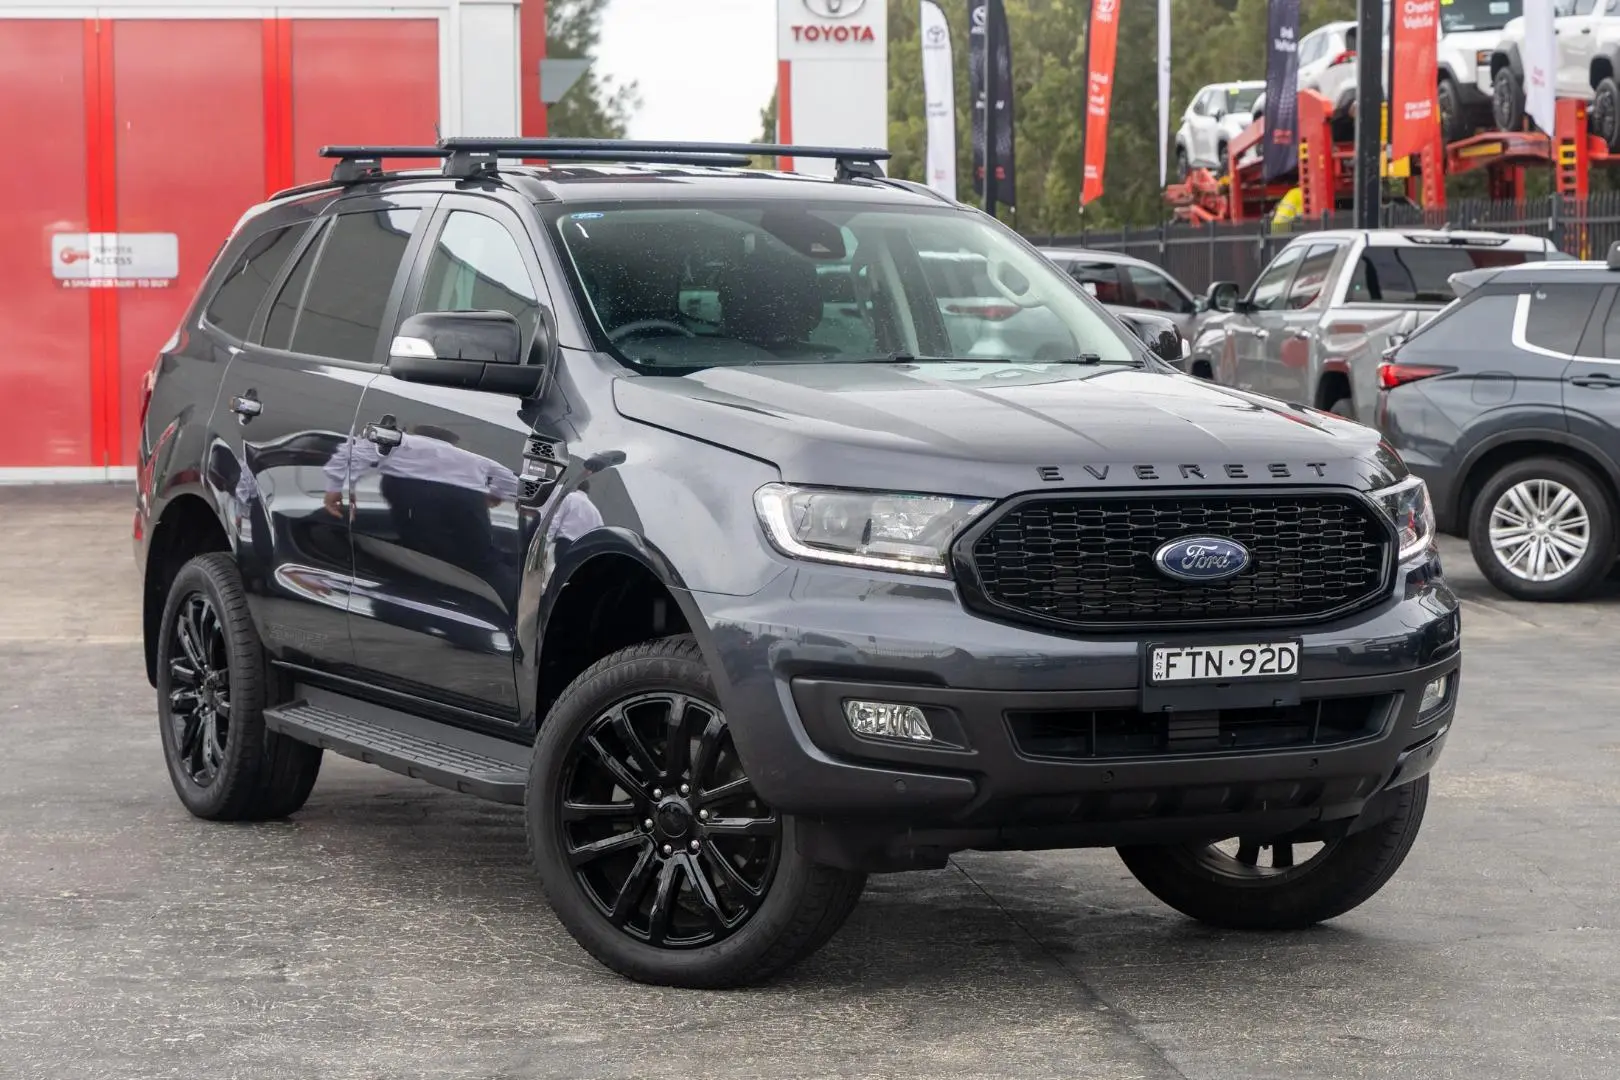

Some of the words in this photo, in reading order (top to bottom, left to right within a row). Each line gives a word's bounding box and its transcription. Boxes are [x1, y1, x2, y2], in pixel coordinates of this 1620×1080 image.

[791, 25, 875, 42] TOYOTA
[1038, 463, 1327, 481] EVEREST
[1181, 545, 1231, 570] Ford
